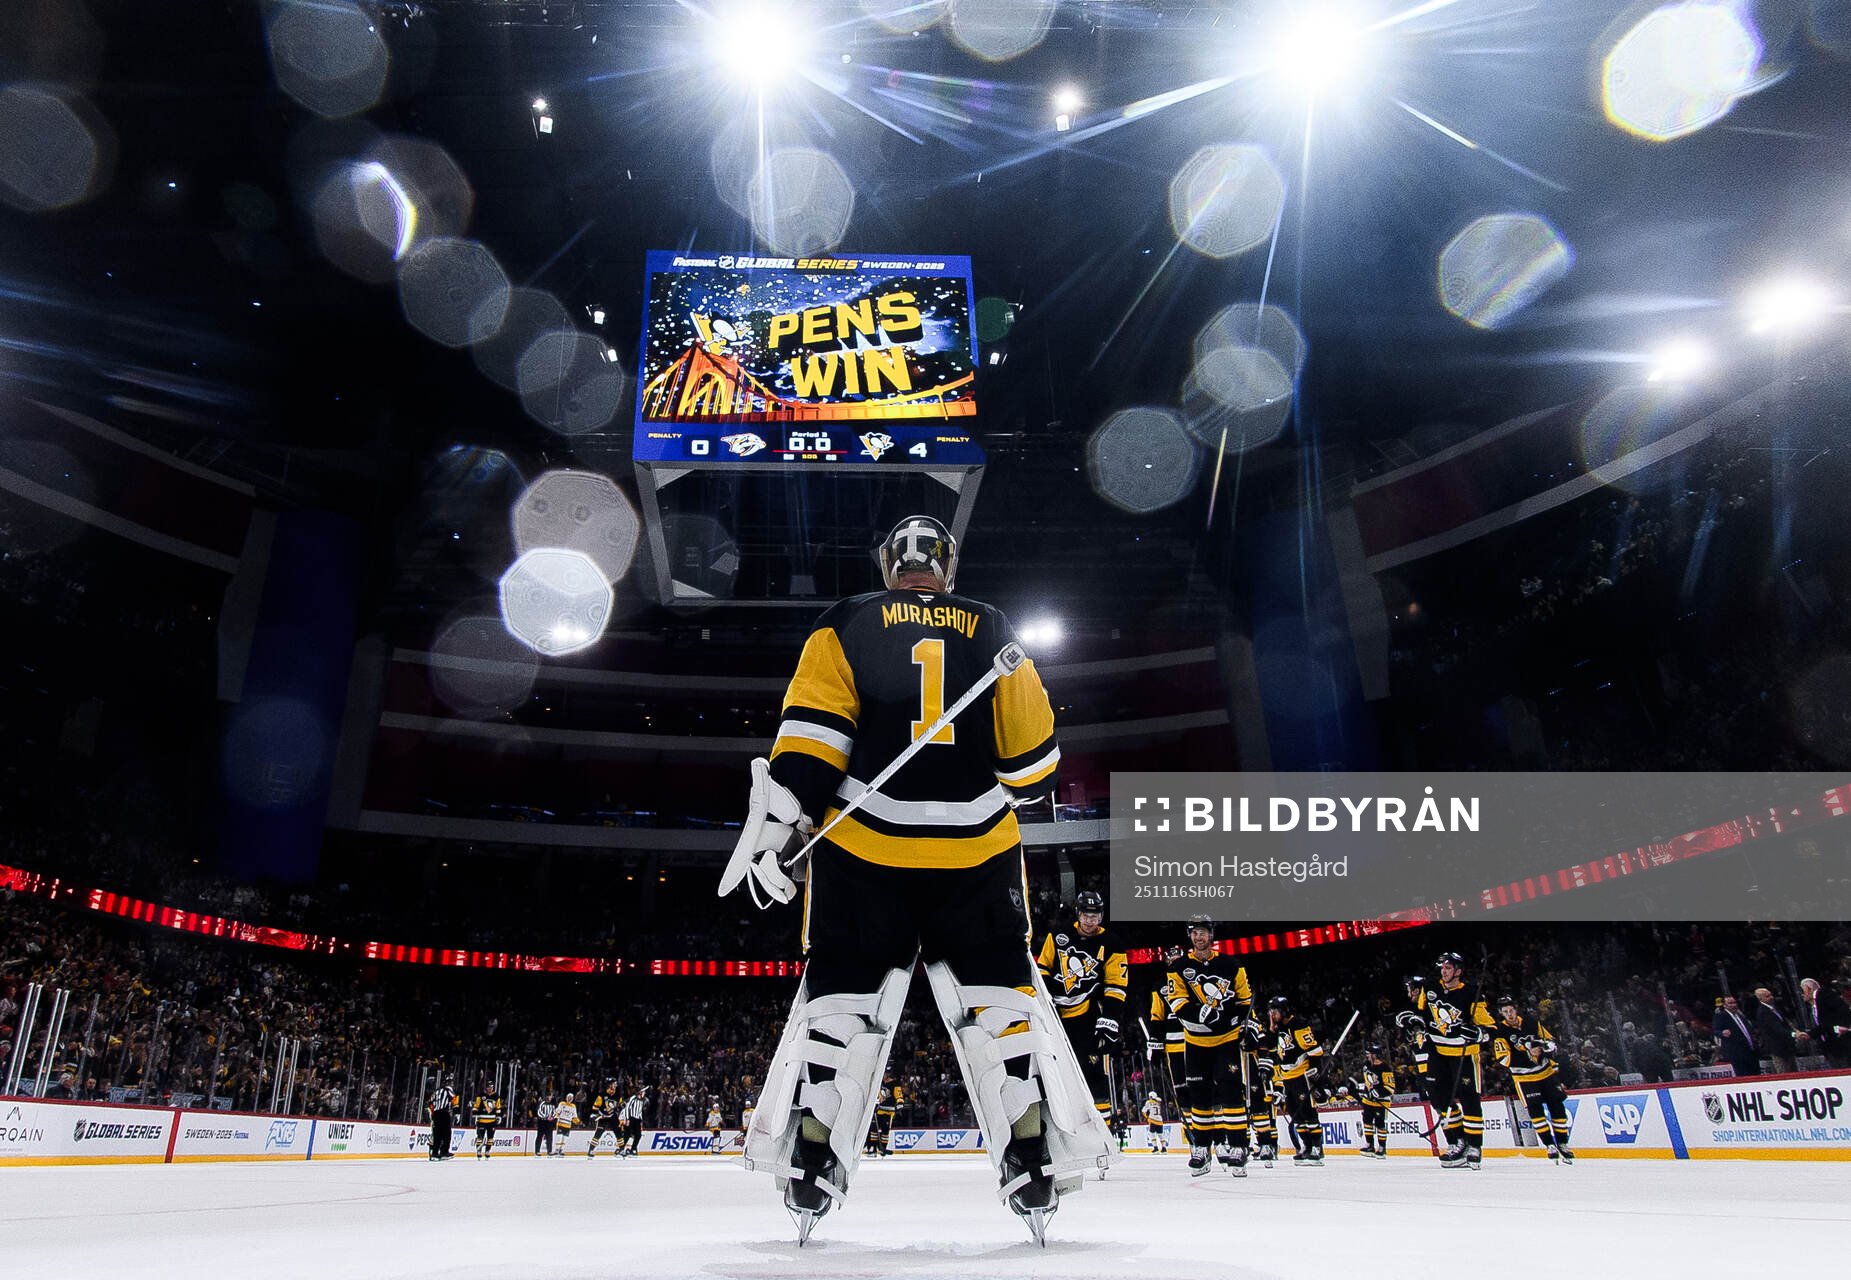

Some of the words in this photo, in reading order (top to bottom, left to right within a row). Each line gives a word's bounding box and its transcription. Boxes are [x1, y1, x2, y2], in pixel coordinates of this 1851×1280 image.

[735, 257, 796, 269] GLOBAL
[796, 258, 858, 270] SERIES
[768, 291, 922, 349] PENS
[790, 346, 913, 398] WIN
[691, 440, 709, 455] 0
[908, 442, 928, 458] 4
[881, 602, 980, 639] MURASHOV
[911, 637, 955, 745] 1
[1726, 1091, 1775, 1123] NHL
[1776, 1087, 1844, 1121] SHOP
[1599, 1103, 1641, 1136] SAP
[84, 1122, 125, 1140] GLOBAL
[124, 1124, 163, 1140] SERIES
[328, 1123, 355, 1140] UNIBET
[895, 1133, 919, 1147] SAP
[937, 1133, 961, 1147] SAP
